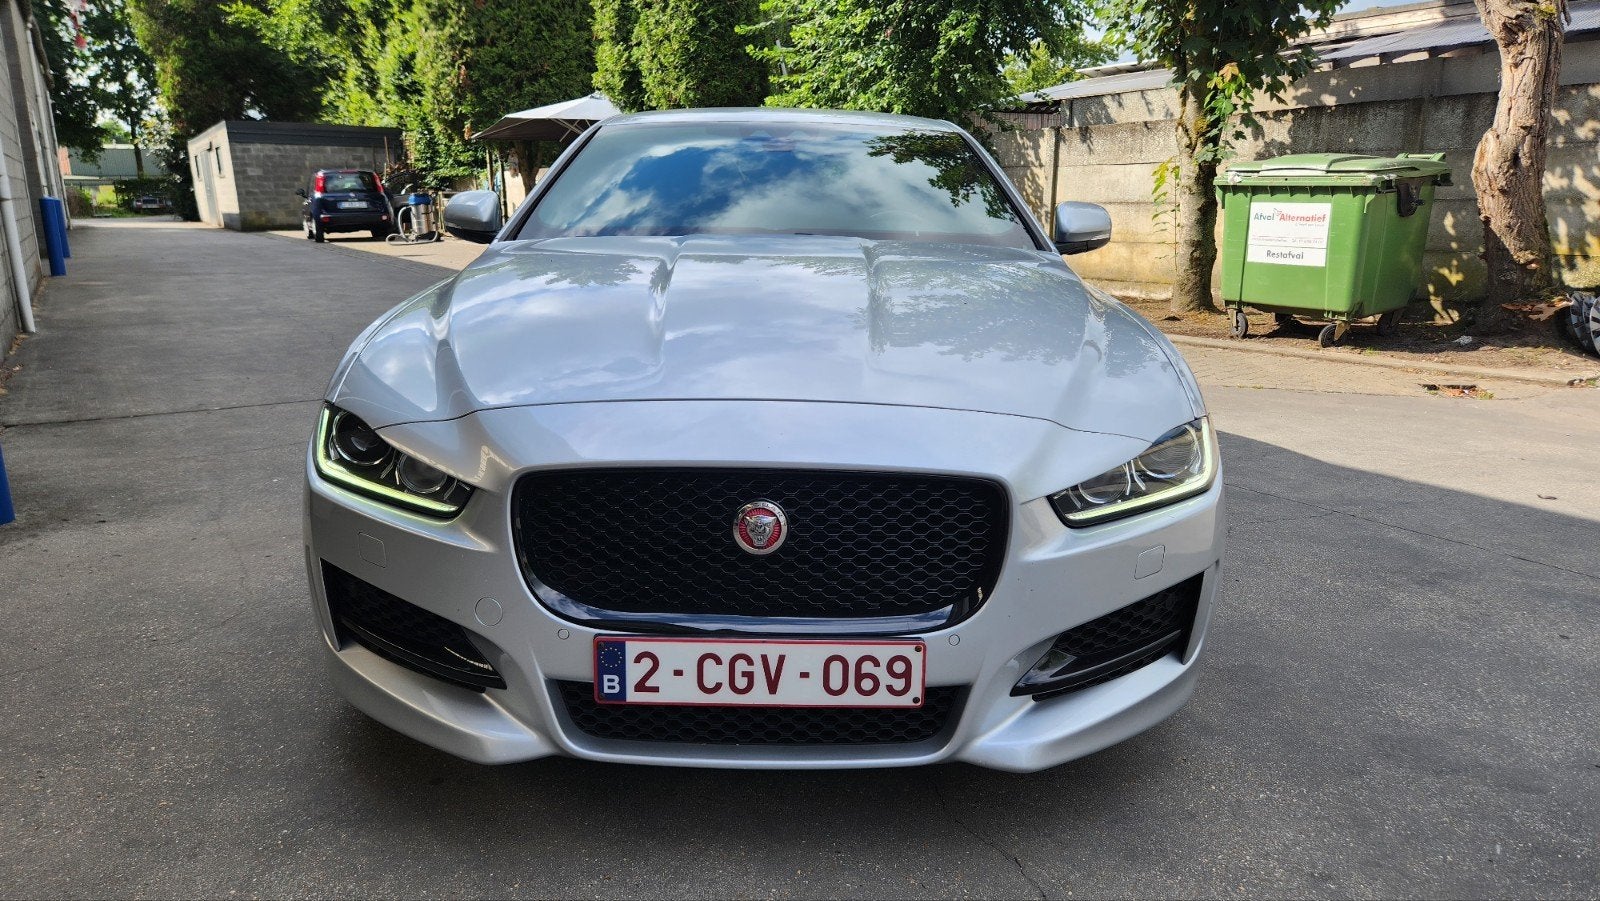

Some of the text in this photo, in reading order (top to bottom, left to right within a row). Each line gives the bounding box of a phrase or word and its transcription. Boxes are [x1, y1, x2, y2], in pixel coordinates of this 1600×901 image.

[1253, 213, 1327, 222] Afval Alternatief
[1266, 249, 1304, 260] Restafval
[603, 675, 620, 694] B
